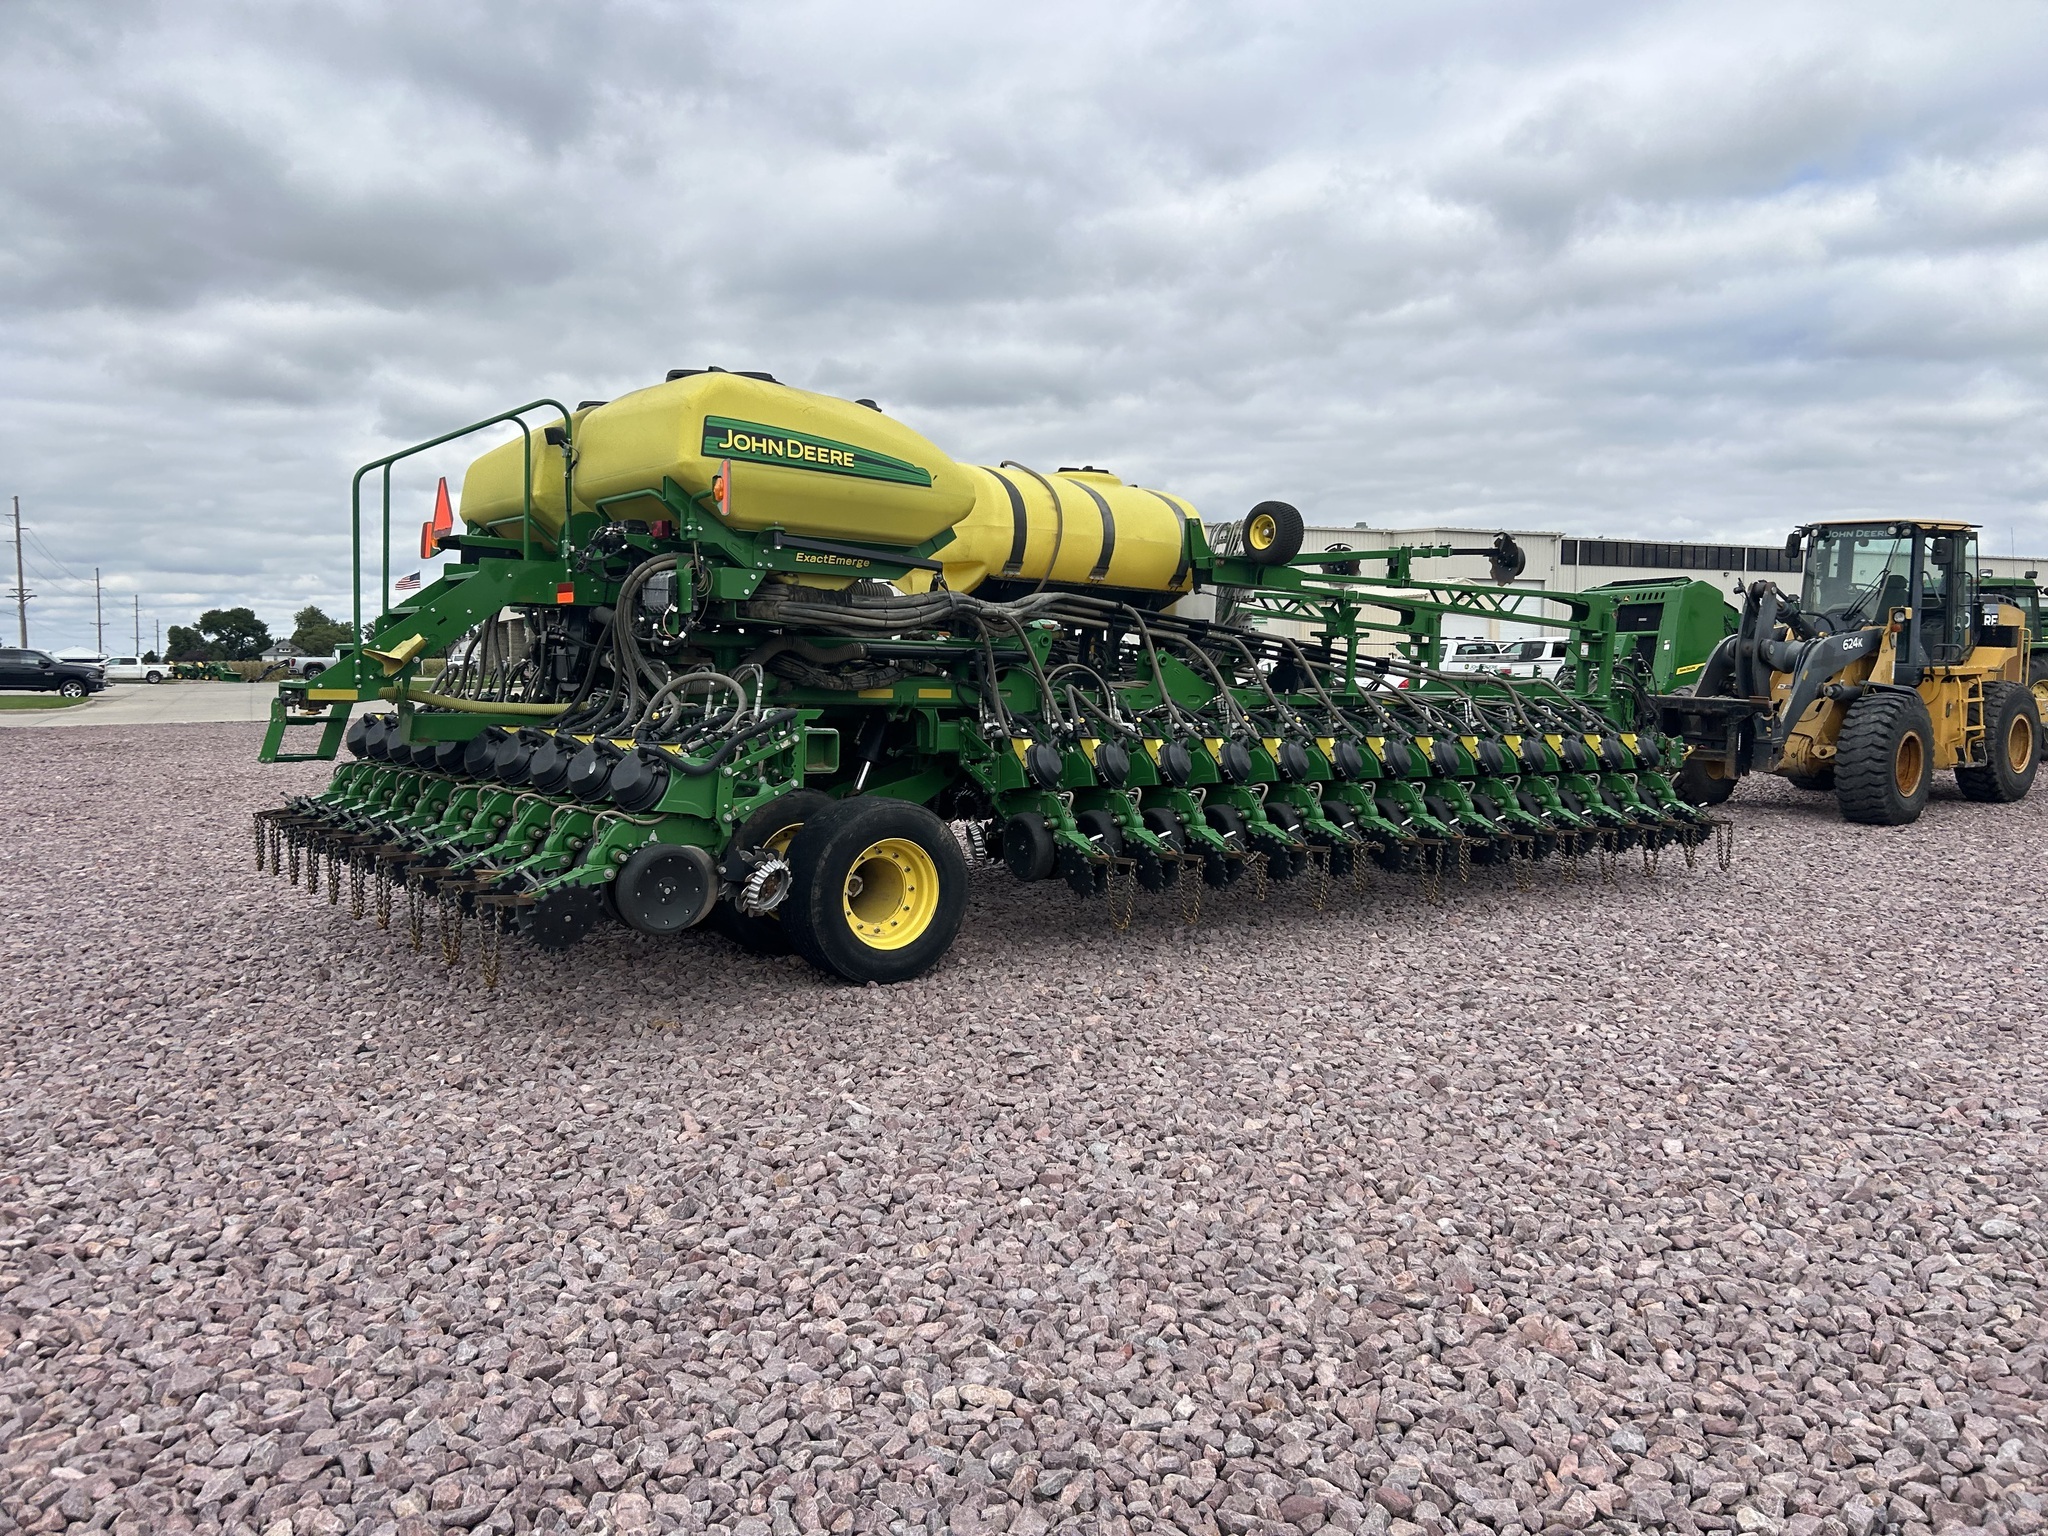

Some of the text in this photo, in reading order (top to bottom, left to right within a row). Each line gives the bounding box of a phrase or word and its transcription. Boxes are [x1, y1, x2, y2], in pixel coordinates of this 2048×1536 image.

[719, 429, 855, 467] JOHN DEERE
[1825, 530, 1854, 538] JOHN
[795, 552, 870, 569] ExactEmerge
